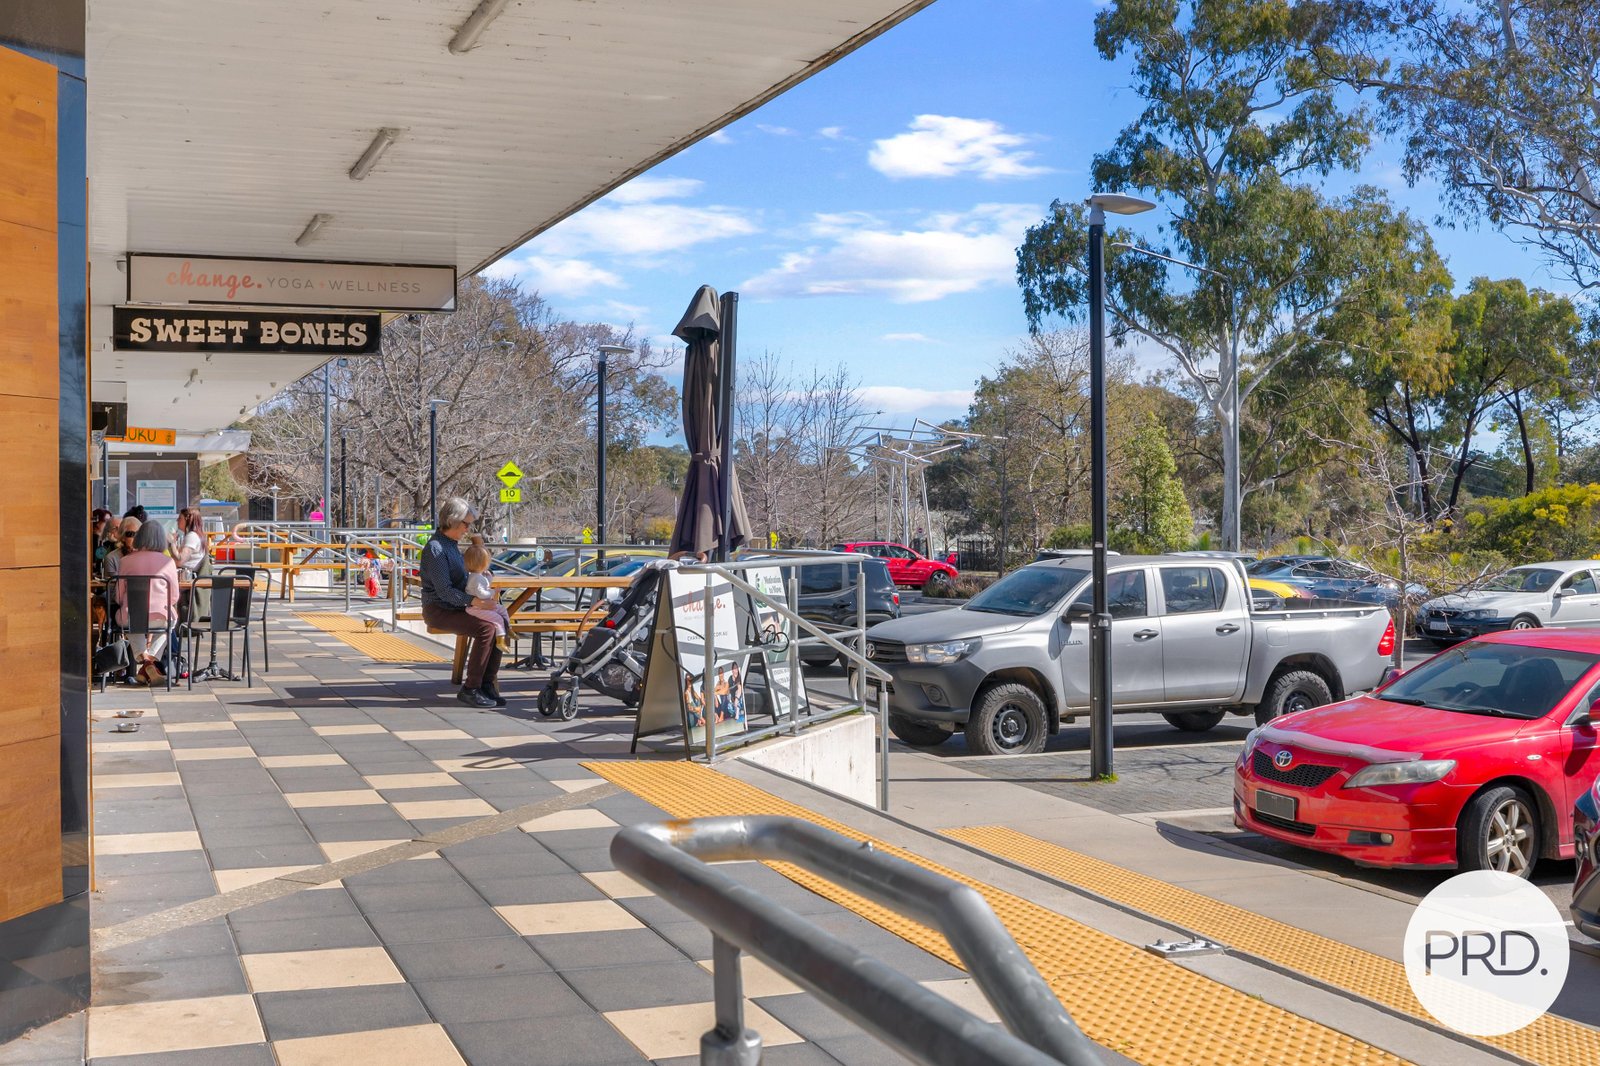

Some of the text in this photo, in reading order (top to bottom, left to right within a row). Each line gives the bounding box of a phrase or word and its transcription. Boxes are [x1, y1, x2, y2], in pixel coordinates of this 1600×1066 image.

[167, 262, 262, 298] change.
[266, 276, 314, 289] YOGA
[328, 279, 421, 293] WELLNESS
[130, 317, 368, 347] SWEET BONES
[121, 428, 156, 442] UKU
[683, 591, 726, 613] chae.
